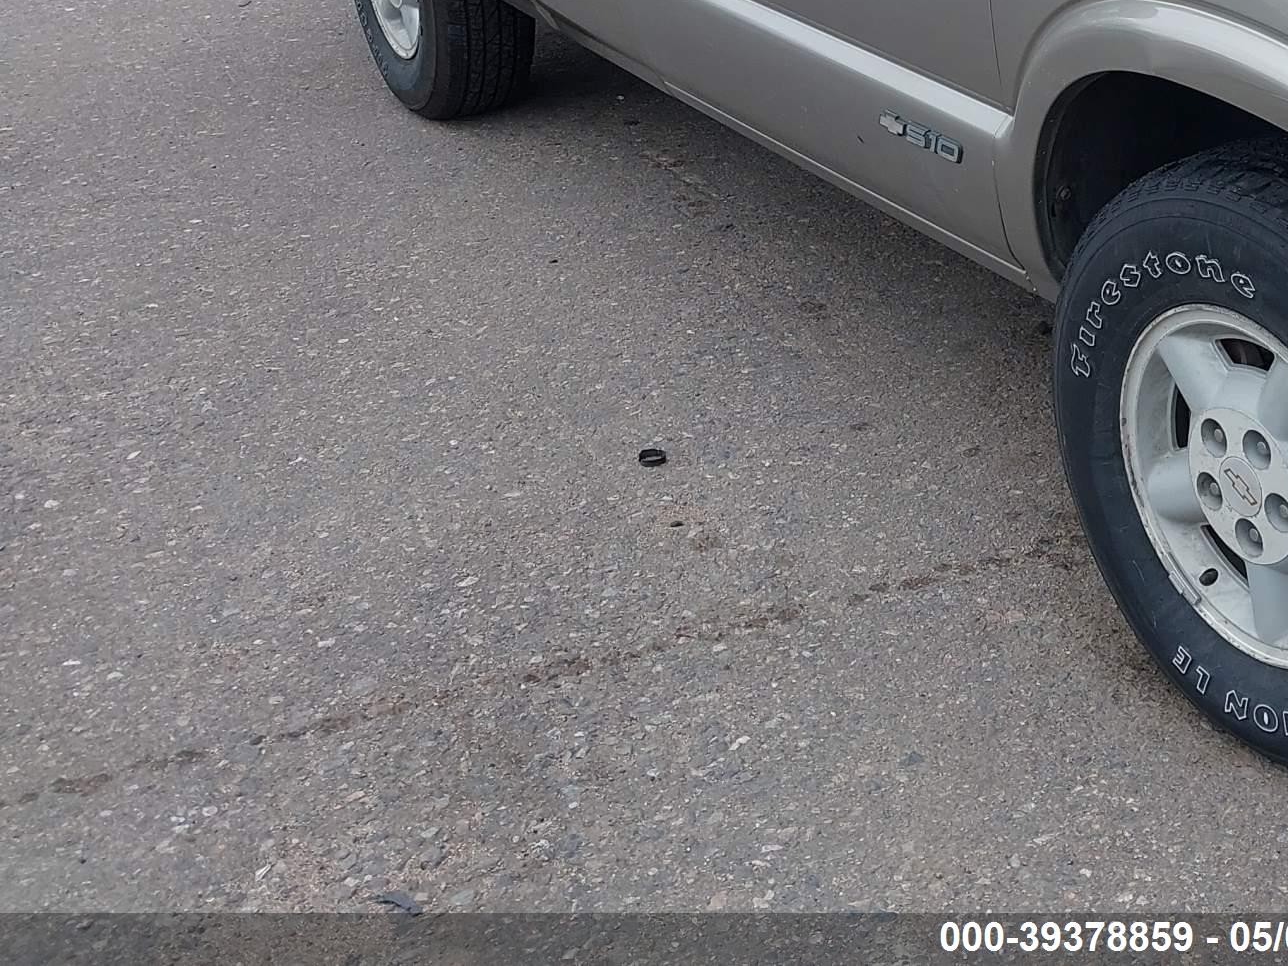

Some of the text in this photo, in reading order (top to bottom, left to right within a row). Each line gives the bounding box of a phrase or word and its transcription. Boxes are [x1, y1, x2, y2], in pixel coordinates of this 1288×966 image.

[906, 122, 963, 163] S10
[1071, 251, 1255, 377] Firestone
[1172, 646, 1210, 695] LE
